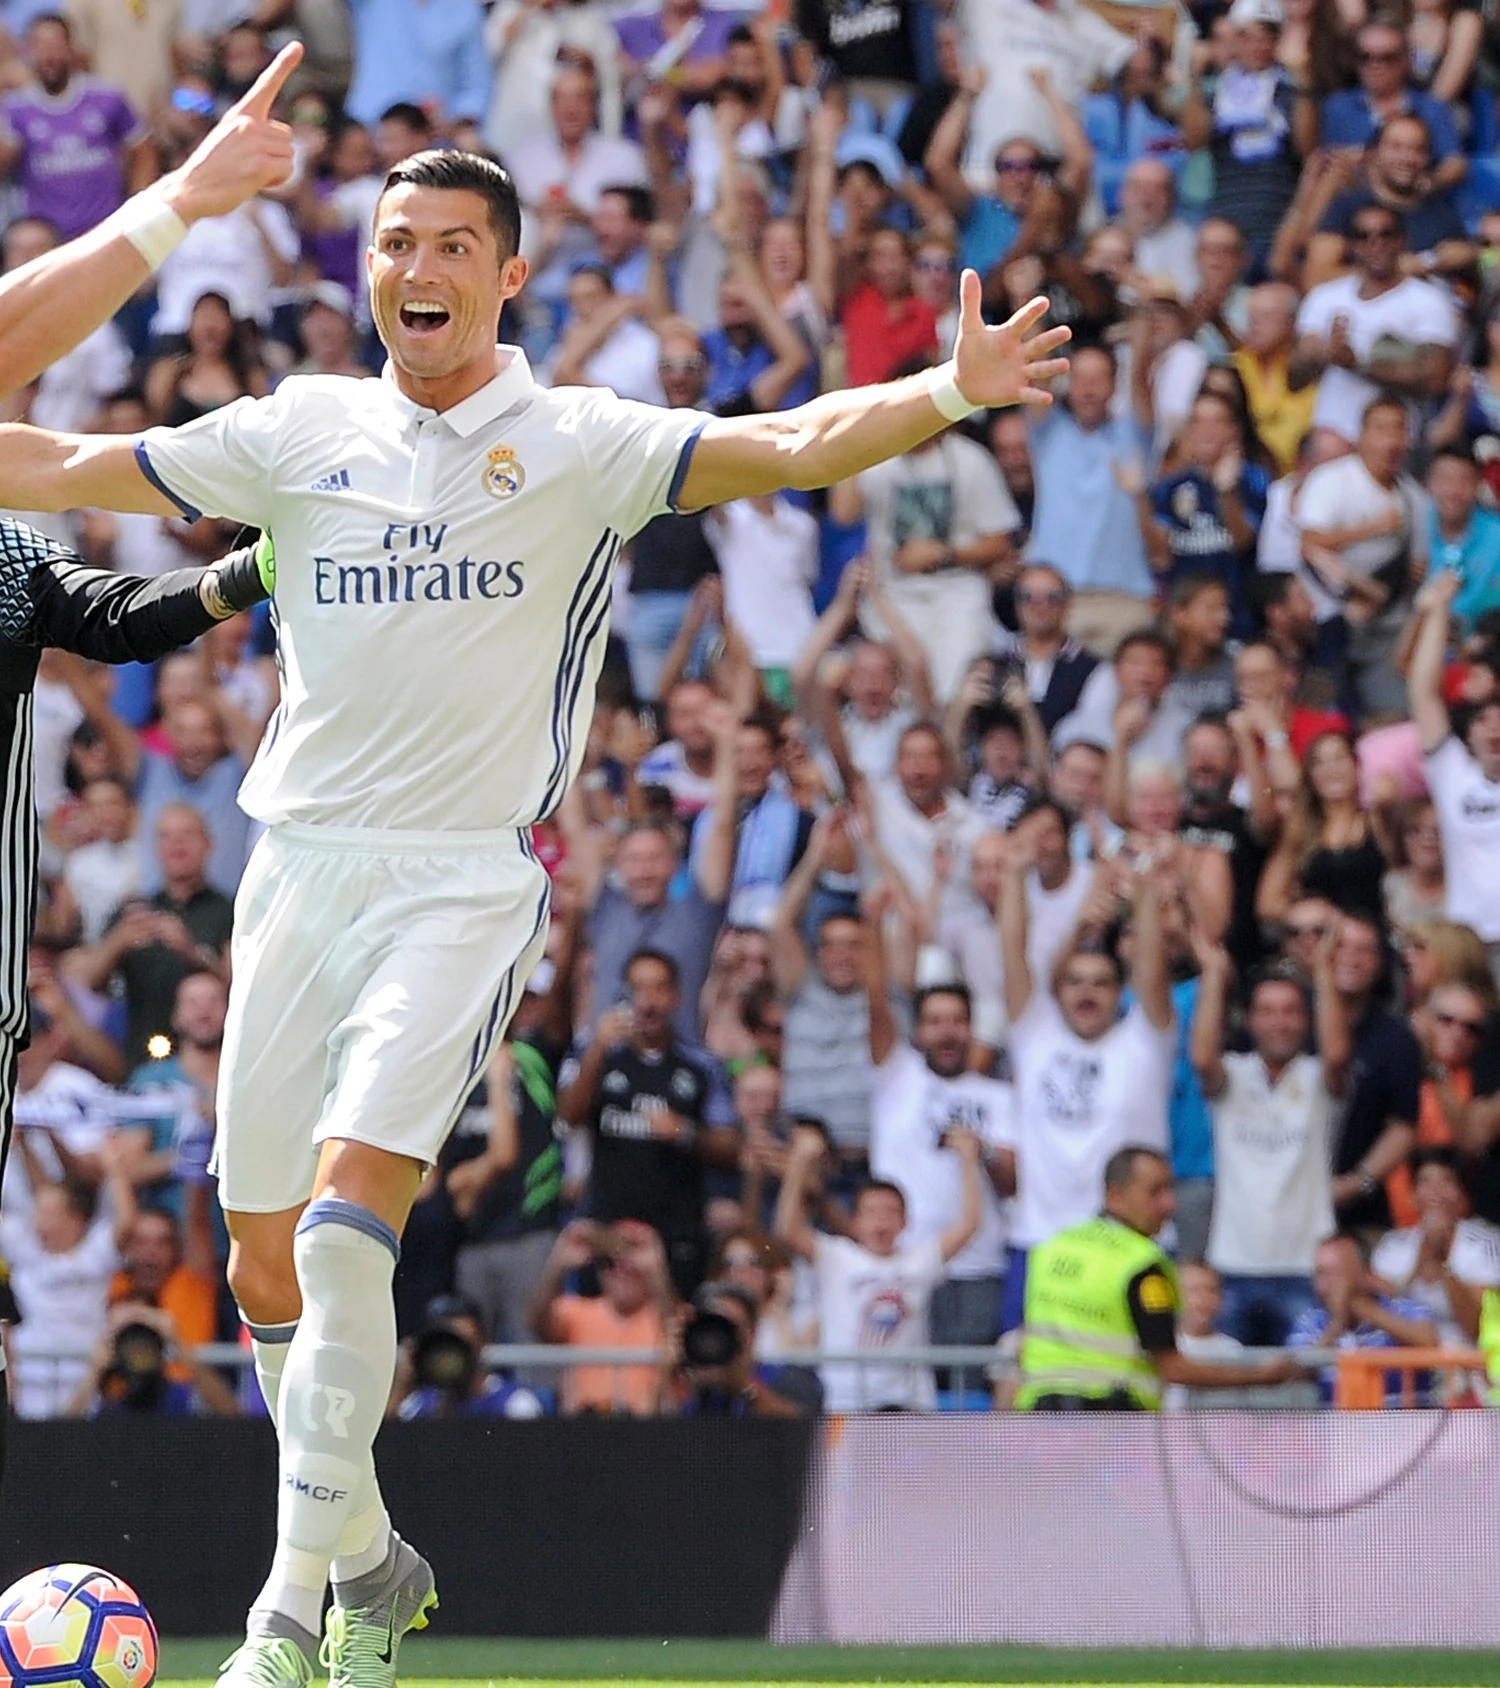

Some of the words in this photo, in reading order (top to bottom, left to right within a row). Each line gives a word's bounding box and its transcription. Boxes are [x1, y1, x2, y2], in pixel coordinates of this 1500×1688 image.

[383, 522, 448, 553] Fly
[313, 554, 526, 606] Emirates
[285, 1473, 348, 1503] RMCF
